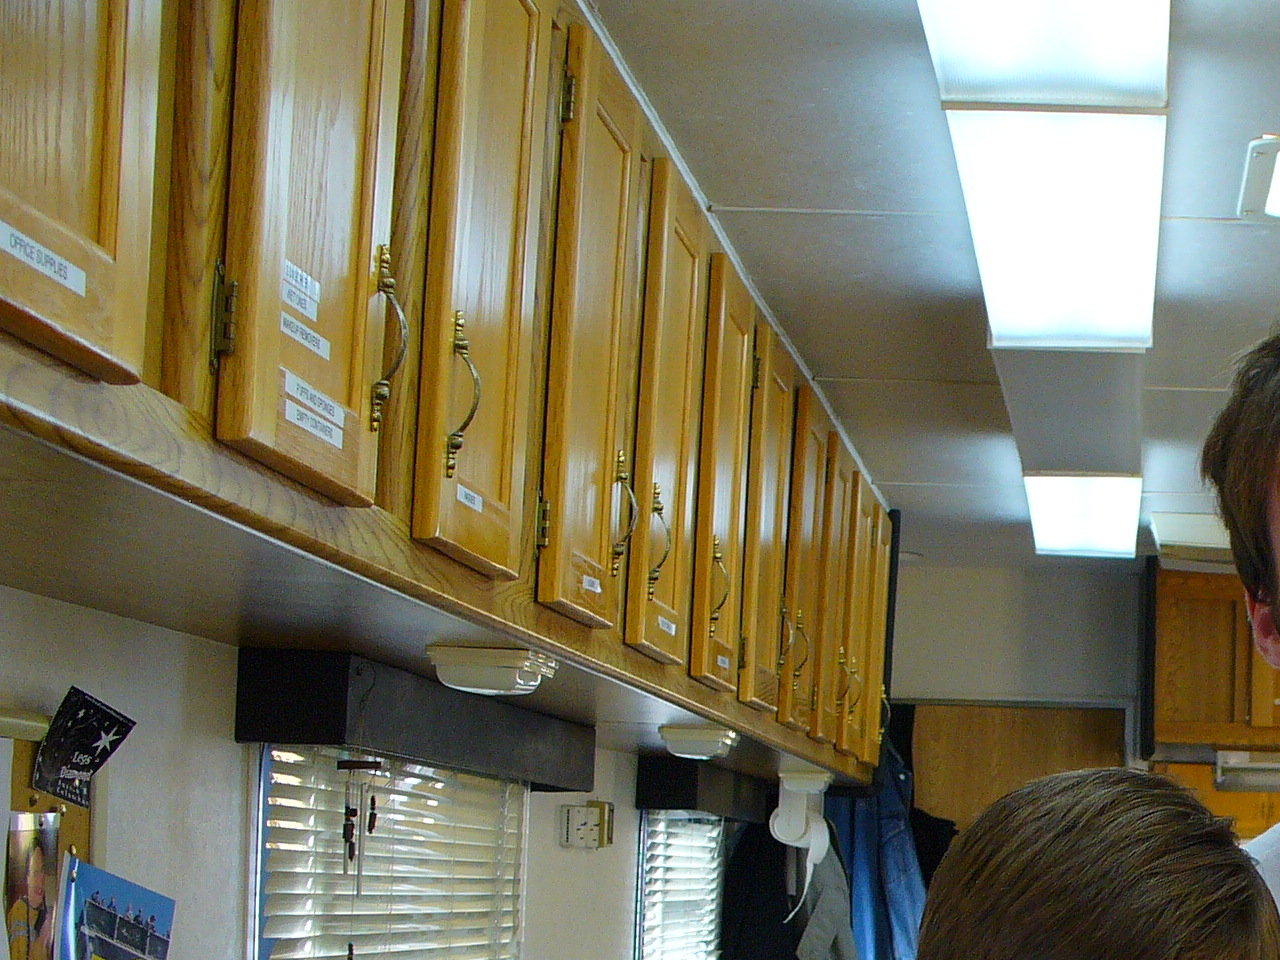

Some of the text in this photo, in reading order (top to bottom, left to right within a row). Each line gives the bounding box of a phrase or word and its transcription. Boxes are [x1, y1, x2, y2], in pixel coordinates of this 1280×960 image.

[10, 233, 67, 280] OFFICE SUPPLIES
[72, 751, 93, 766] Legs
